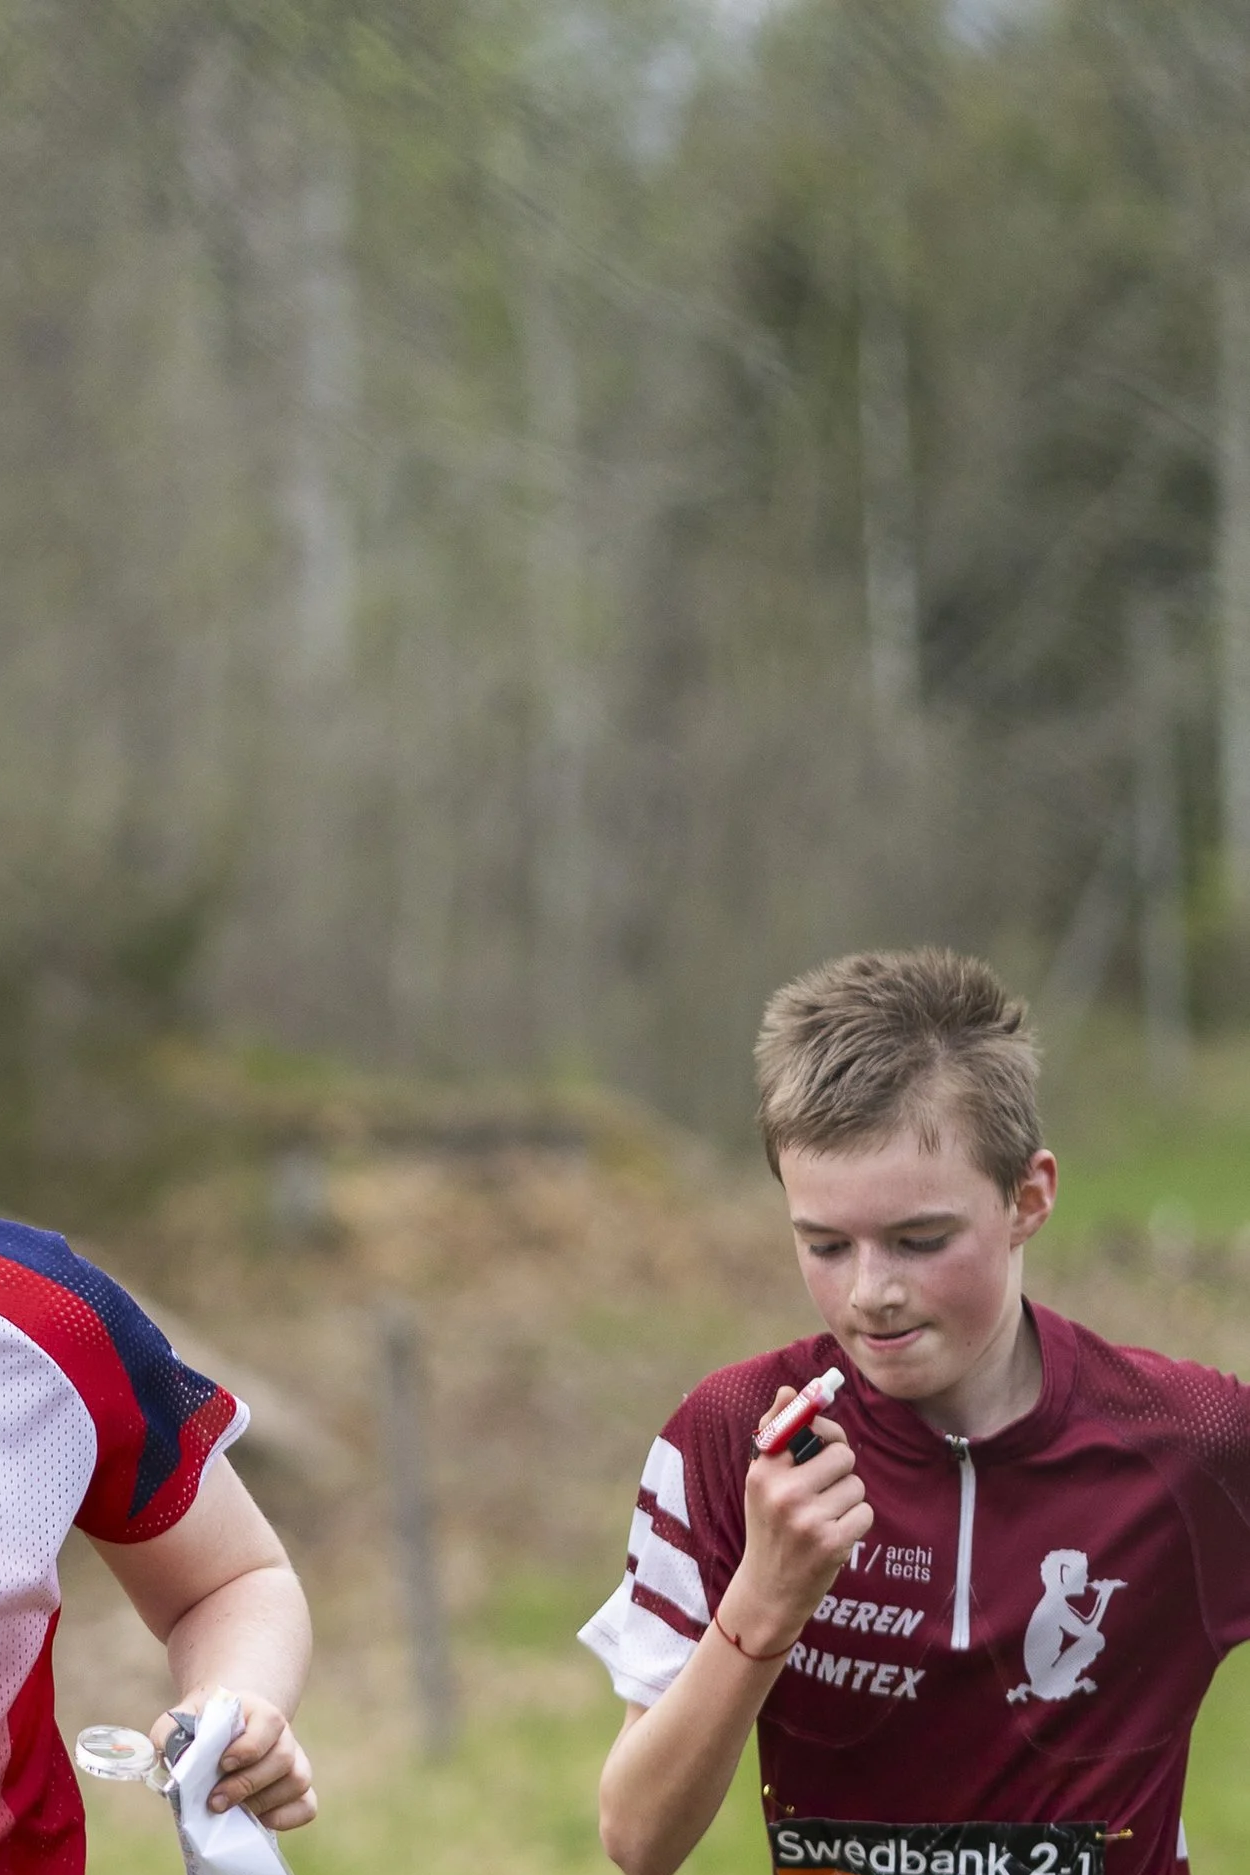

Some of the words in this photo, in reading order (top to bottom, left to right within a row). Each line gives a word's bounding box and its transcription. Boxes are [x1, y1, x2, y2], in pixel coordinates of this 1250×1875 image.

[886, 1546, 933, 1566] archi
[884, 1559, 931, 1582] tects
[786, 1641, 926, 1699] RIMTEX
